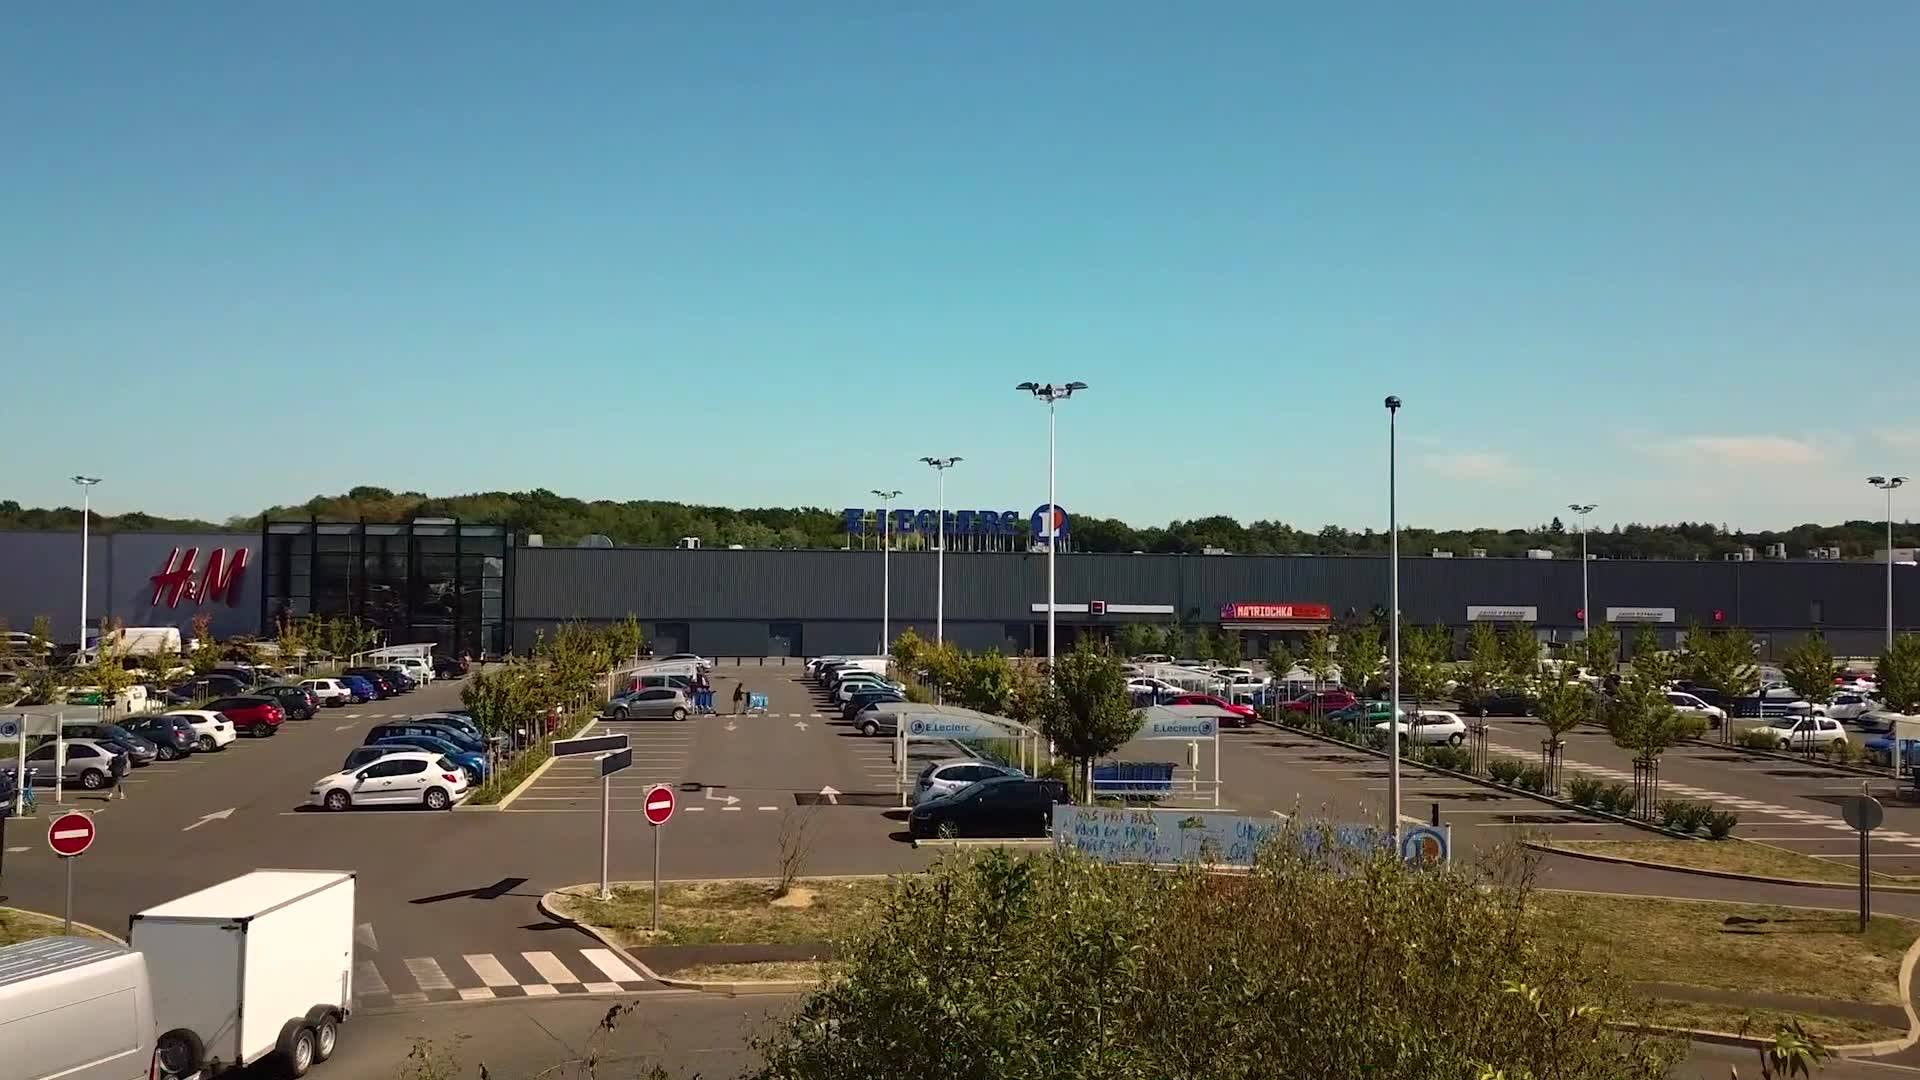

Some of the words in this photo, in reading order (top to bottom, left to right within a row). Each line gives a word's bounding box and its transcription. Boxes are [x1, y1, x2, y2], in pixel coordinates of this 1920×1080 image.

[150, 547, 249, 608] H&M
[925, 723, 971, 732] E.Leclerc
[1153, 723, 1199, 733] E.Leclerc
